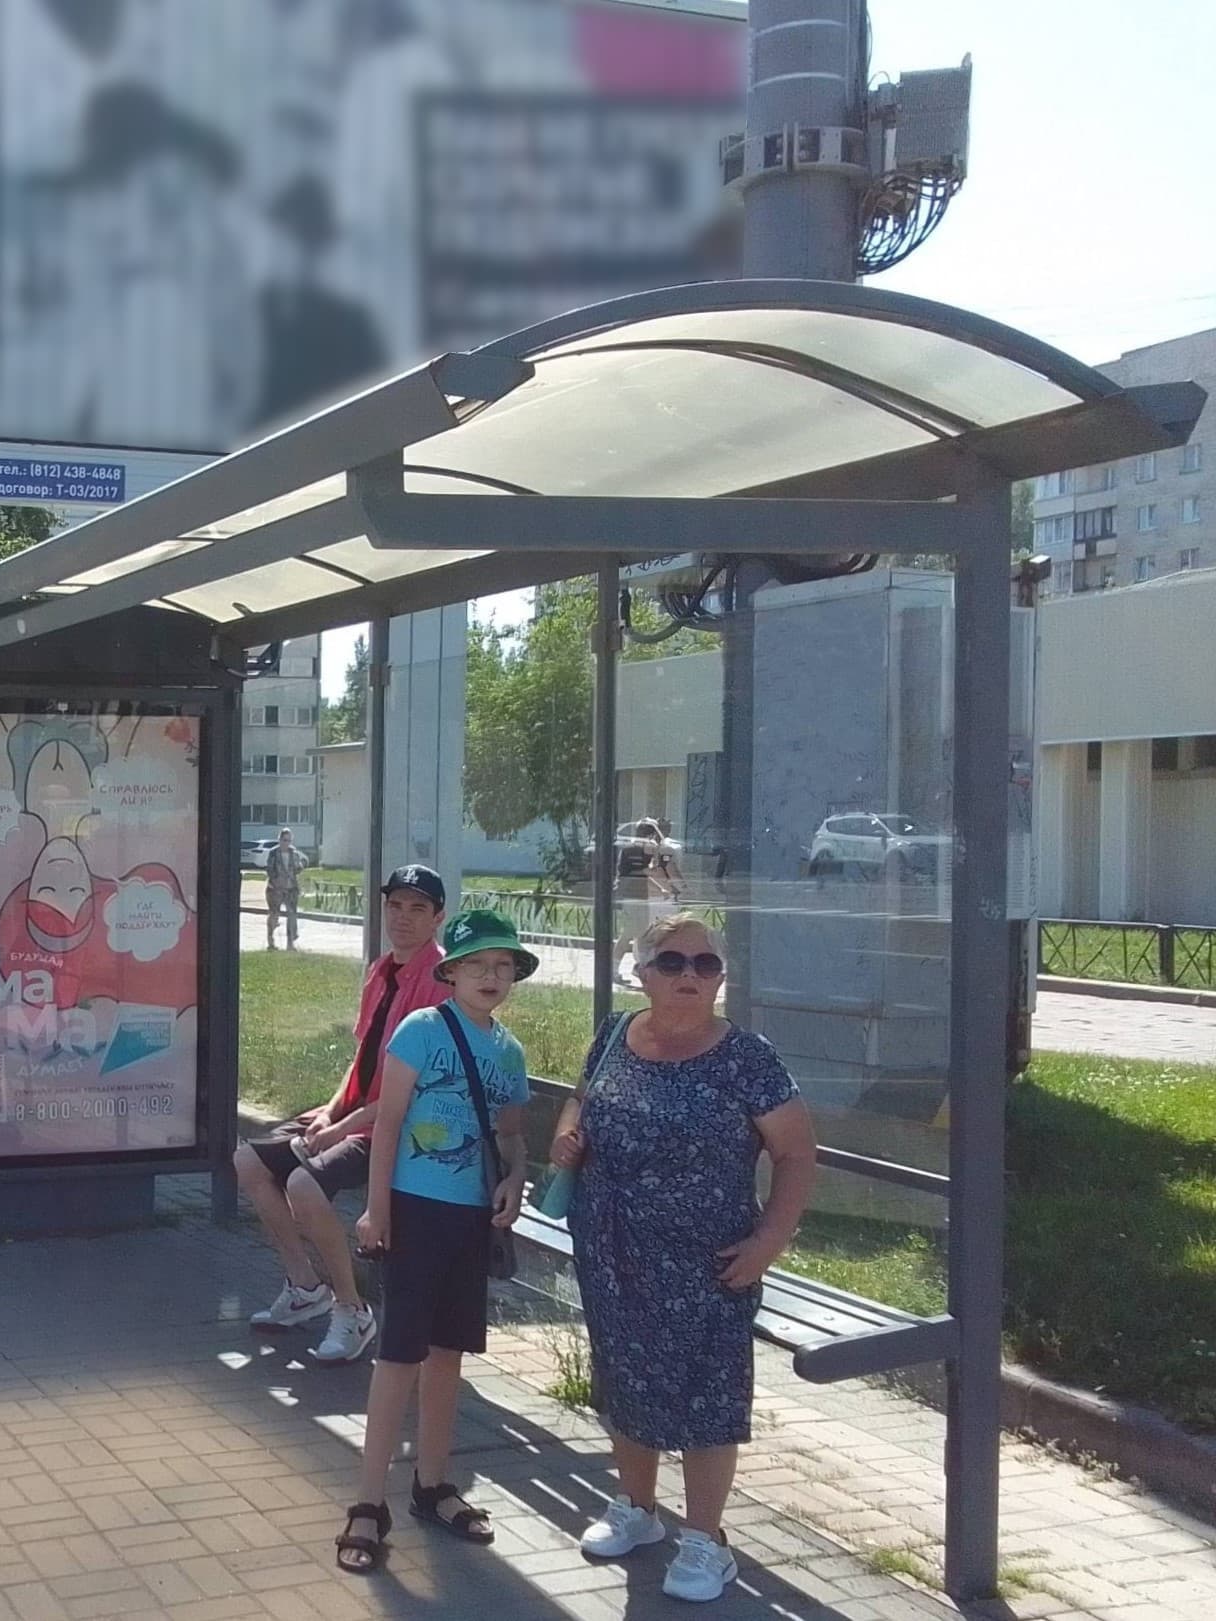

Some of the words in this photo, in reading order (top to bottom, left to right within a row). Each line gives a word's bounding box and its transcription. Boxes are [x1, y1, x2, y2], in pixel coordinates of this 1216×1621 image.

[30, 463, 61, 478] (812)
[64, 467, 121, 480] 438-4848
[57, 485, 118, 498] Т-03/2017
[99, 783, 175, 794] СПРАВЛЮСЬ
[120, 795, 136, 806] ЛИ
[140, 795, 153, 806] Я?
[10, 952, 64, 968] БУДУЩАЯ
[17, 1057, 89, 1077] ДУМАЕТ
[14, 1093, 176, 1121] 8-800-2000-492
